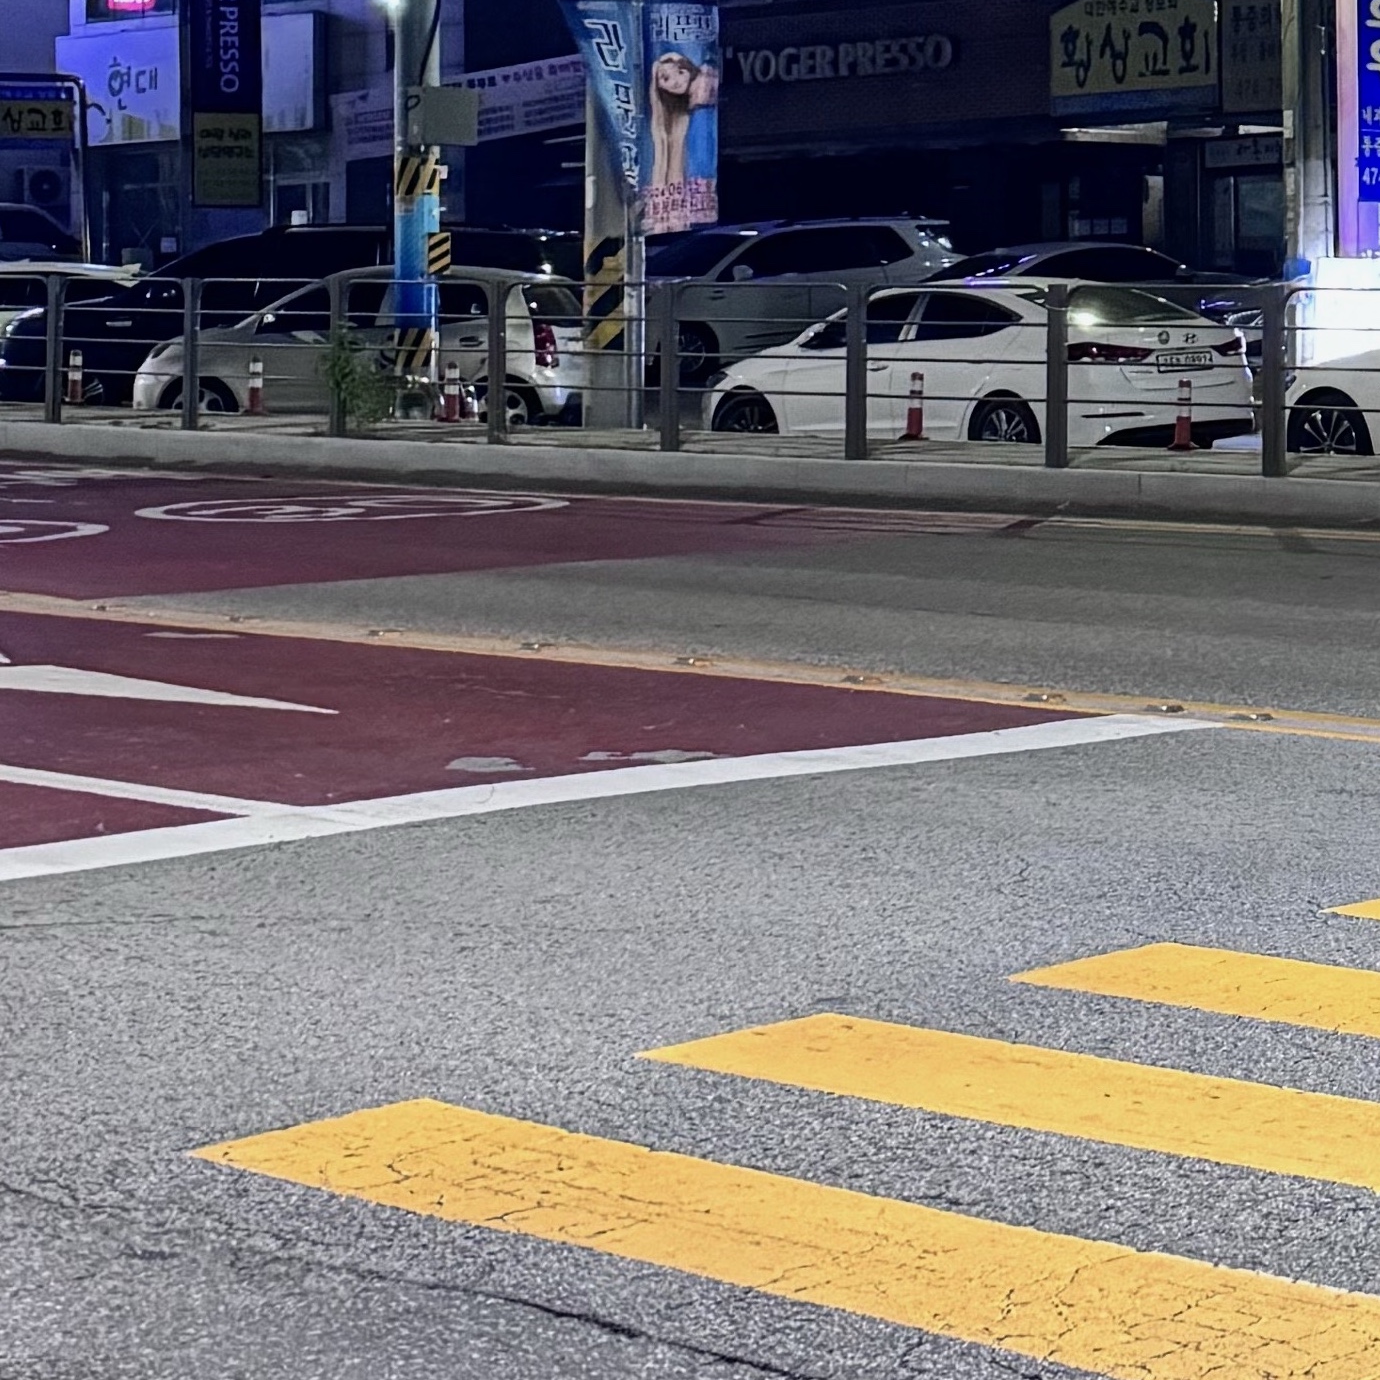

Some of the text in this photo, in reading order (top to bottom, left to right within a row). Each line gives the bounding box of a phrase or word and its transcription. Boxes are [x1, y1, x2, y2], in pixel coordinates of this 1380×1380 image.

[108, 56, 158, 113] 현대
[218, 7, 241, 95] PRESSO
[1060, 16, 1210, 88] 황상교회
